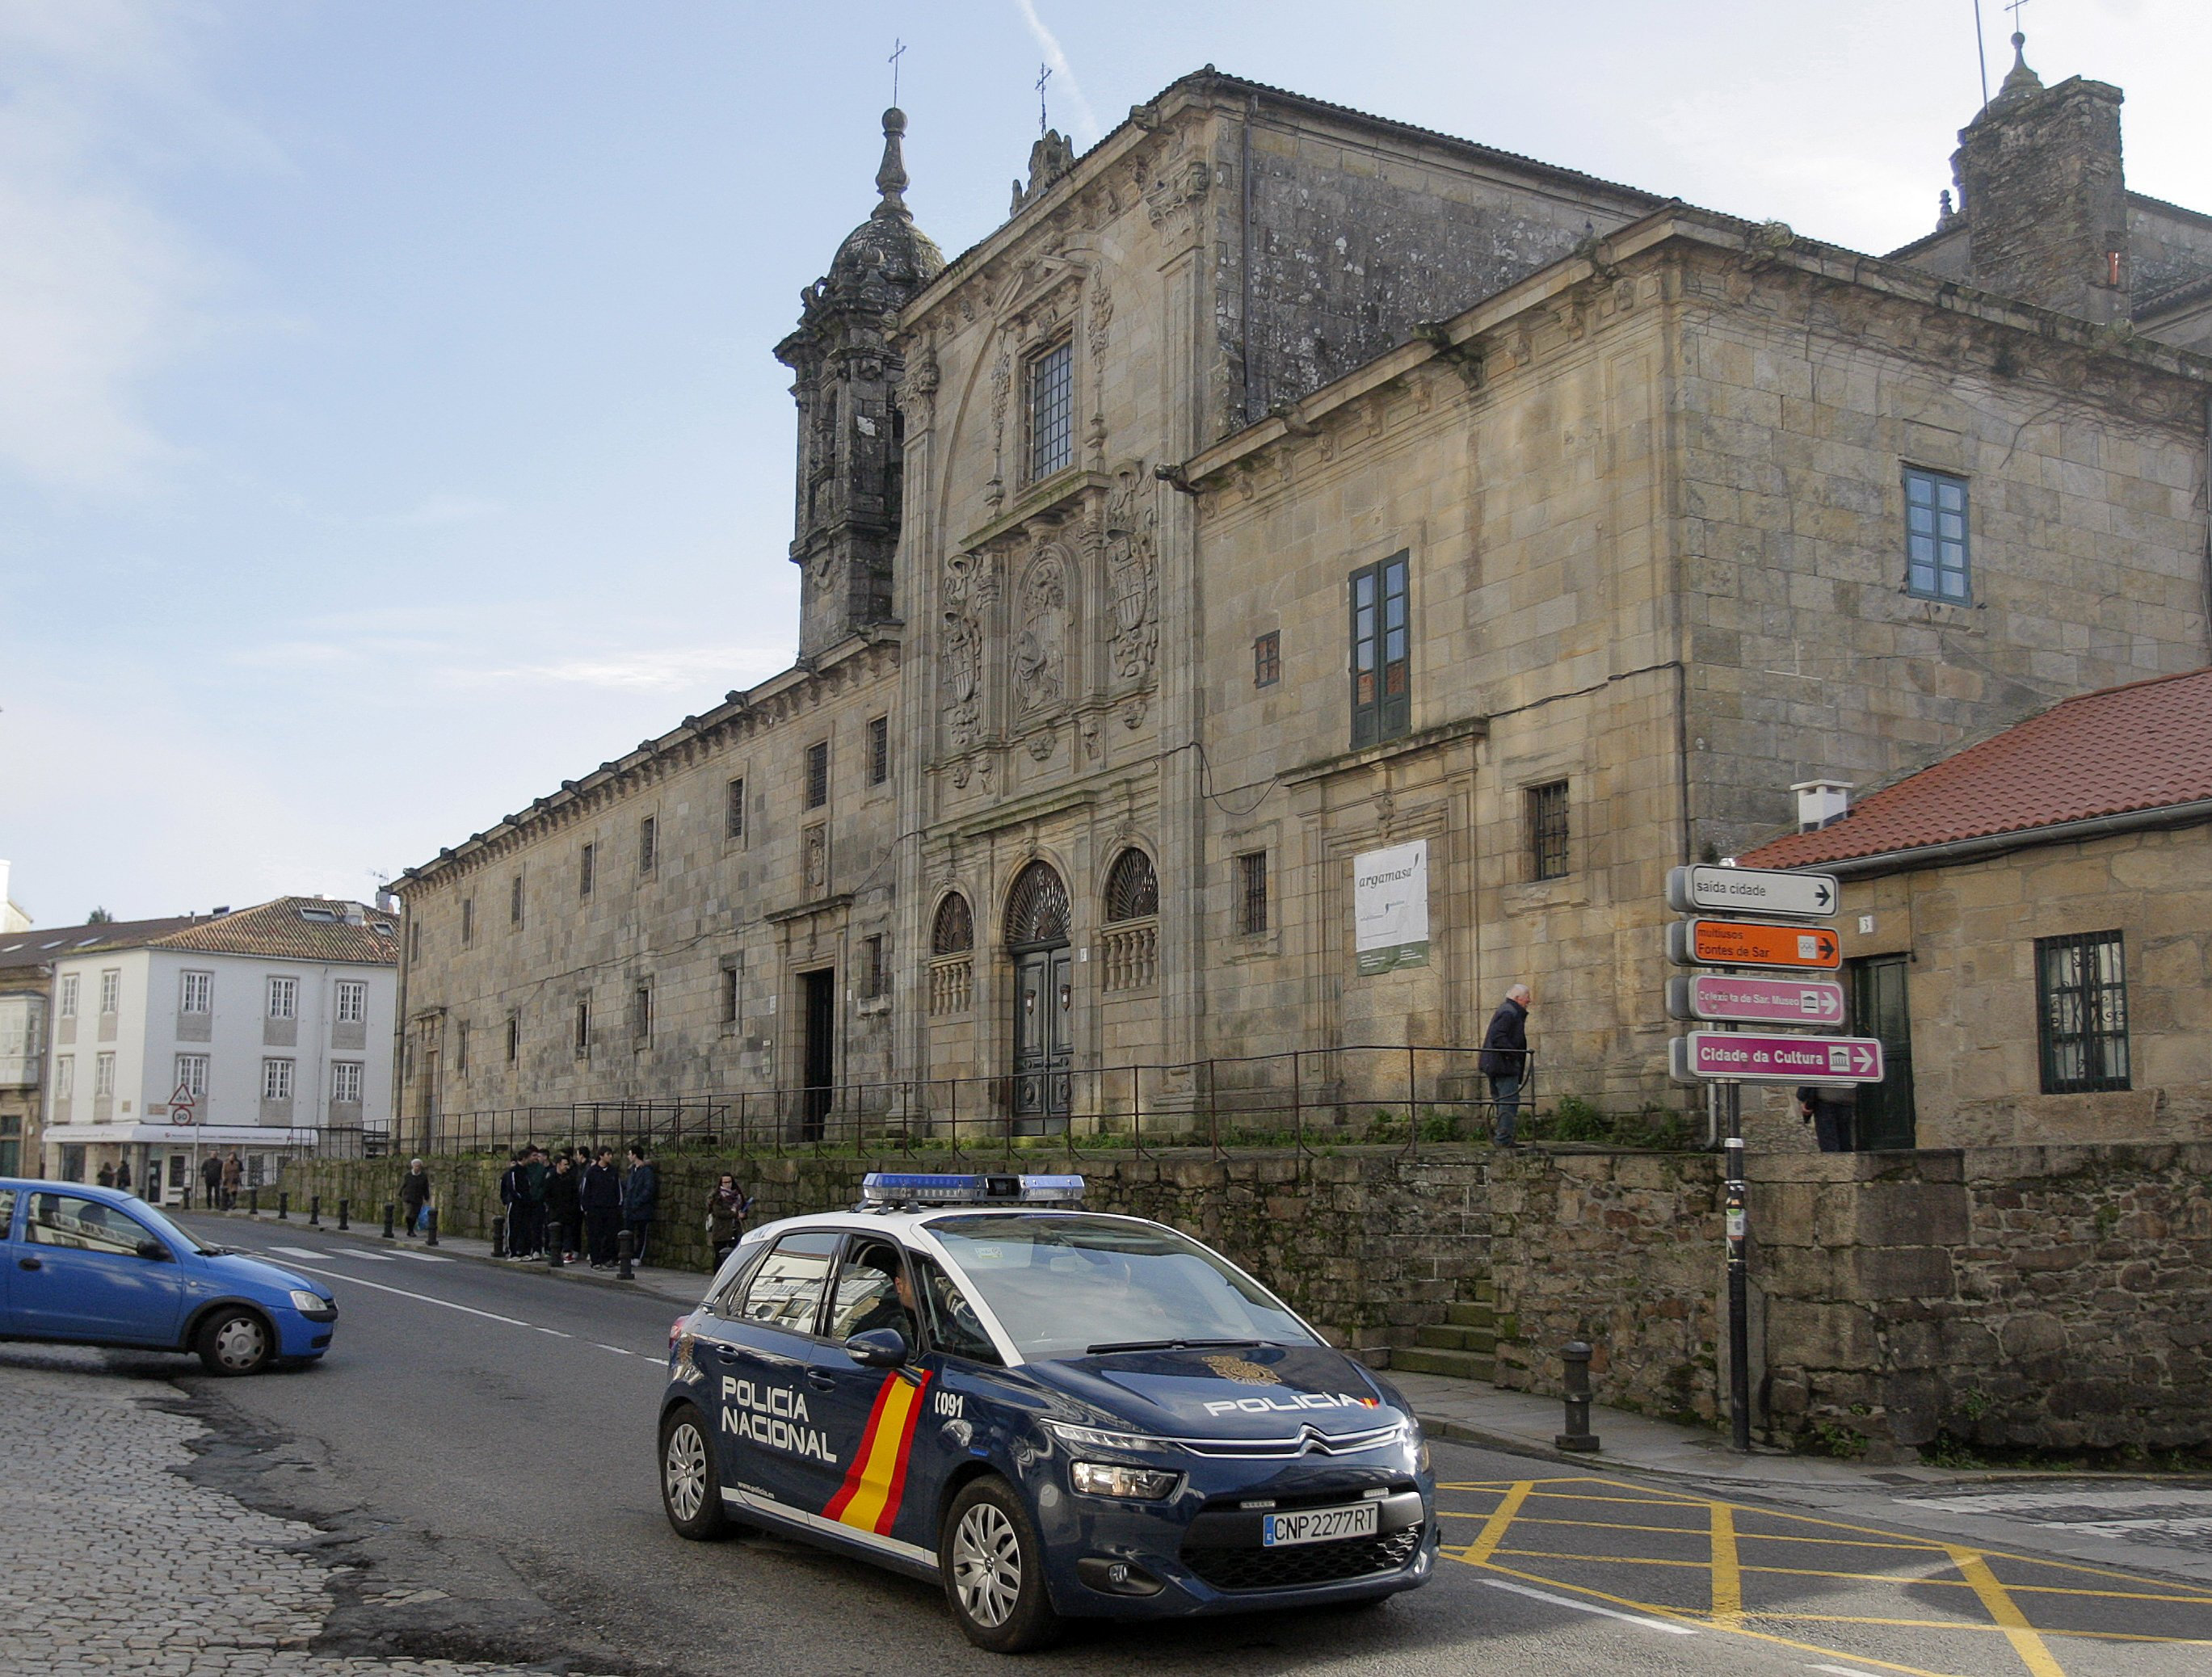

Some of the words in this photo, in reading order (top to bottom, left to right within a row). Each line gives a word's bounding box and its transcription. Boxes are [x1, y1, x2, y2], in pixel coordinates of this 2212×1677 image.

[1359, 867, 1412, 889] argamasa
[1697, 881, 1726, 893] saída
[1730, 883, 1766, 897] cidade
[1697, 928, 1743, 939] multiusos
[1698, 944, 1733, 956] Fontes
[1736, 946, 1749, 956] de
[1752, 947, 1770, 958] Sar
[1740, 994, 1752, 1003] de
[1772, 995, 1799, 1006] Museo
[1701, 1047, 1748, 1062] Cidade
[1752, 1050, 1769, 1062] da
[1774, 1050, 1823, 1065] Cultura
[721, 1375, 810, 1422] POLICÍA
[940, 1392, 963, 1418] 091
[1203, 1391, 1365, 1416] POLICÍA
[721, 1406, 837, 1463] NACIONAL
